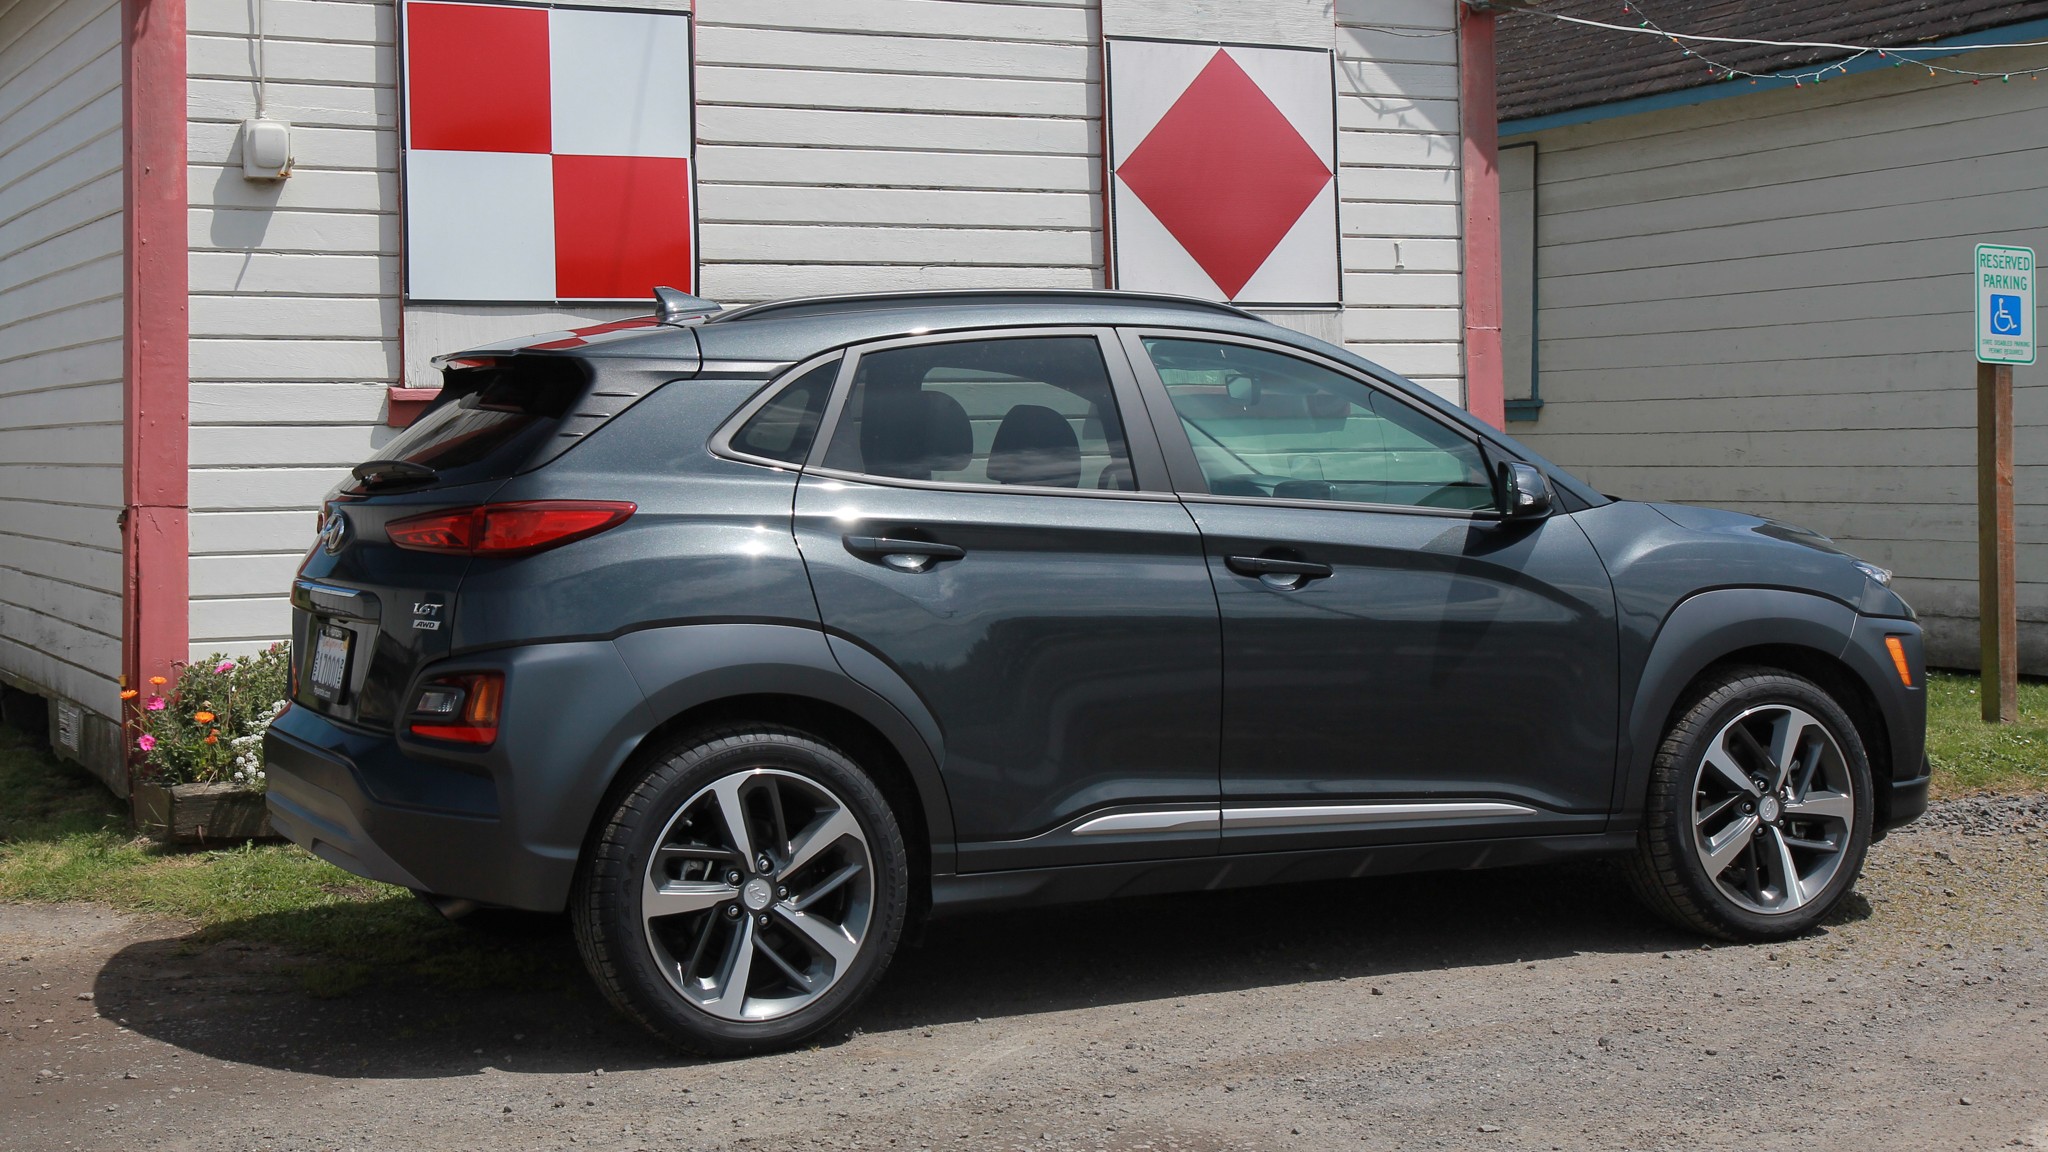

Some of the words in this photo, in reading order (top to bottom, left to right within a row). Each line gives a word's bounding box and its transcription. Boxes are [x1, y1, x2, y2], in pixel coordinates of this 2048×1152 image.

[1980, 253, 2030, 271] RESERVED
[1983, 273, 2027, 291] PARKING
[416, 621, 435, 629] AWD
